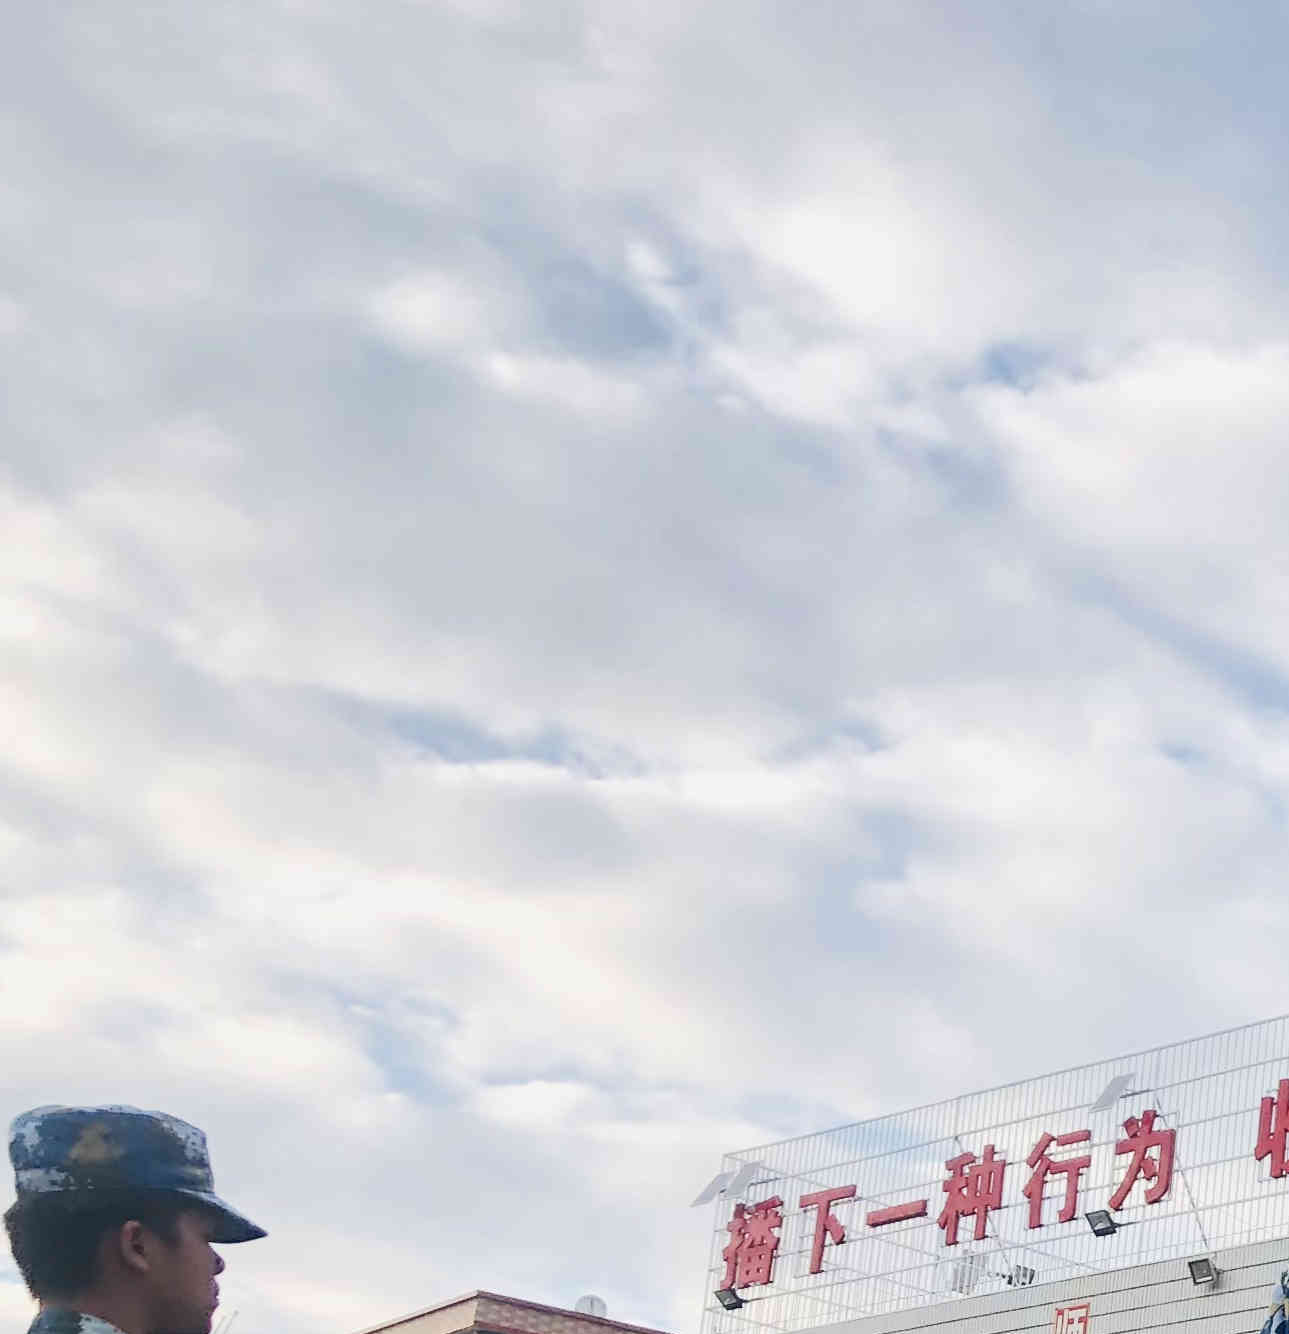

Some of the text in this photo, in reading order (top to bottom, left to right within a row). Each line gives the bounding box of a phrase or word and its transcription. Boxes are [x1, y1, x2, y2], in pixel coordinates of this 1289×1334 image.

[720, 1109, 1176, 1289] 播下一种行为
